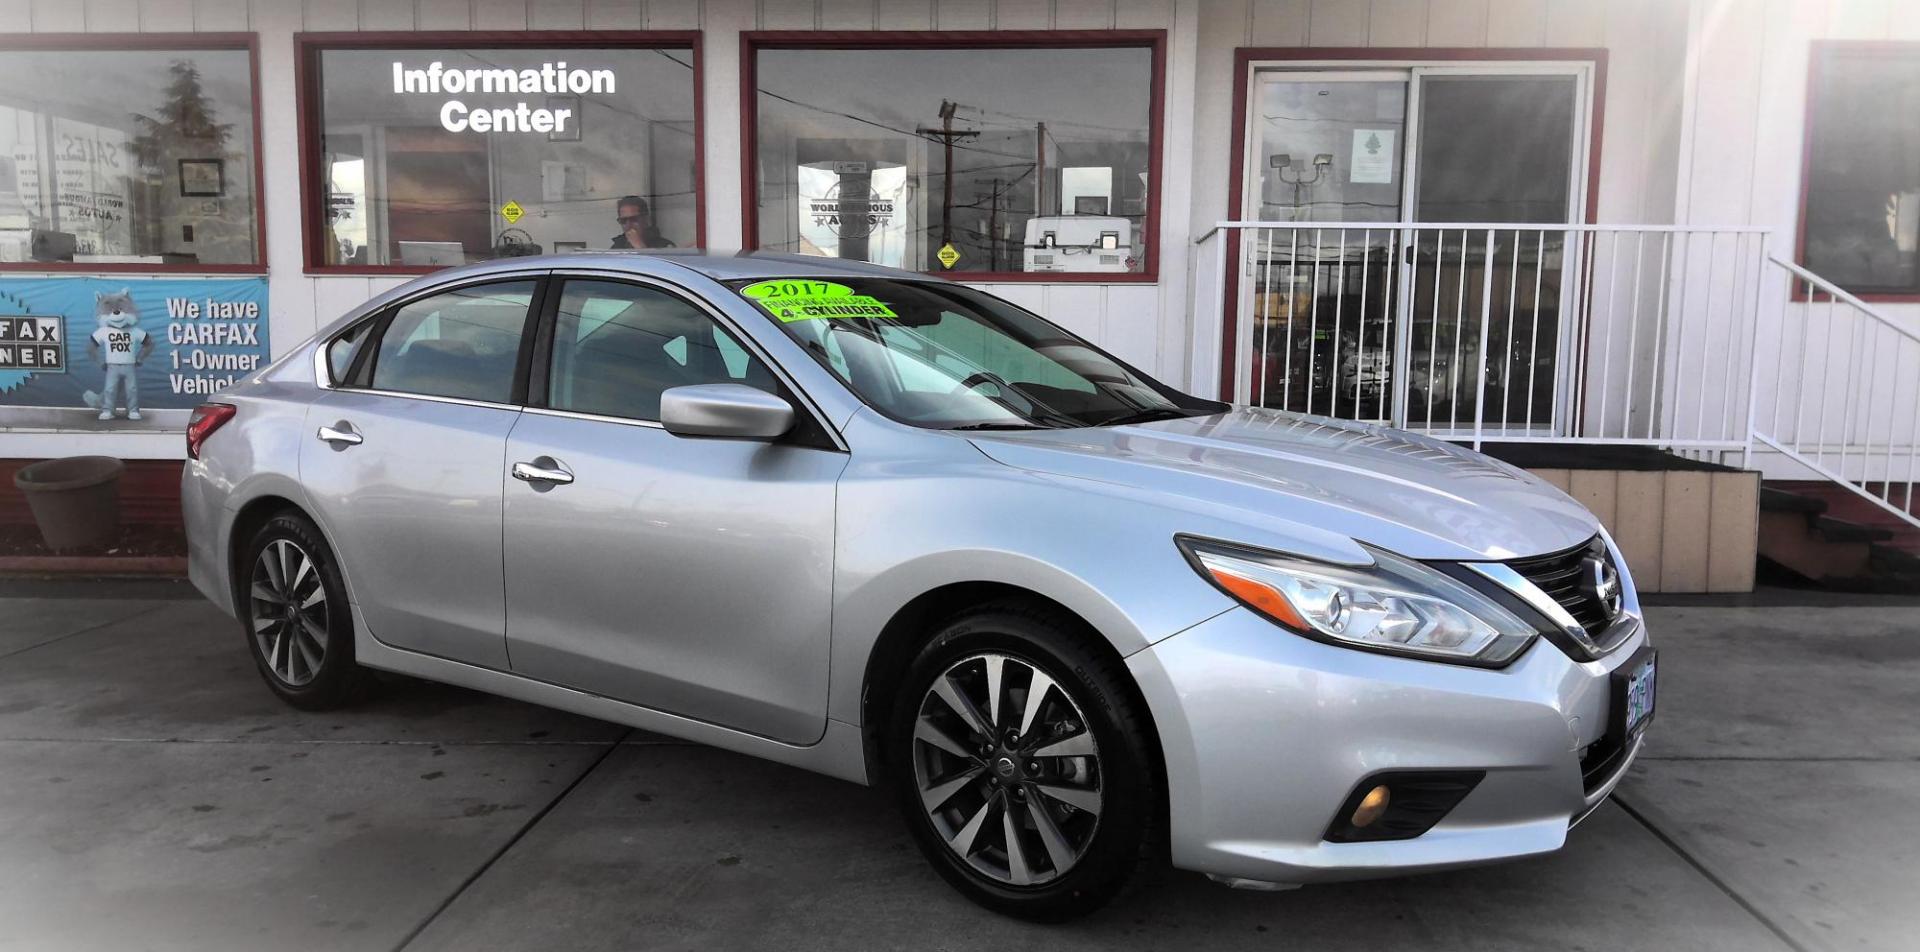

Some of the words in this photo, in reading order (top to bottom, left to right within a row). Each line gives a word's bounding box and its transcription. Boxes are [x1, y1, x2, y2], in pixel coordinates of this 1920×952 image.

[393, 62, 615, 93] Information
[440, 100, 572, 133] Center
[763, 283, 829, 298] 2017
[166, 298, 200, 319] We
[206, 298, 258, 319] have
[108, 332, 131, 343] CAR
[168, 323, 258, 345] CARFAX
[110, 342, 131, 353] FOX
[169, 349, 260, 370] 1-Owner
[170, 374, 240, 394] Vehicl
